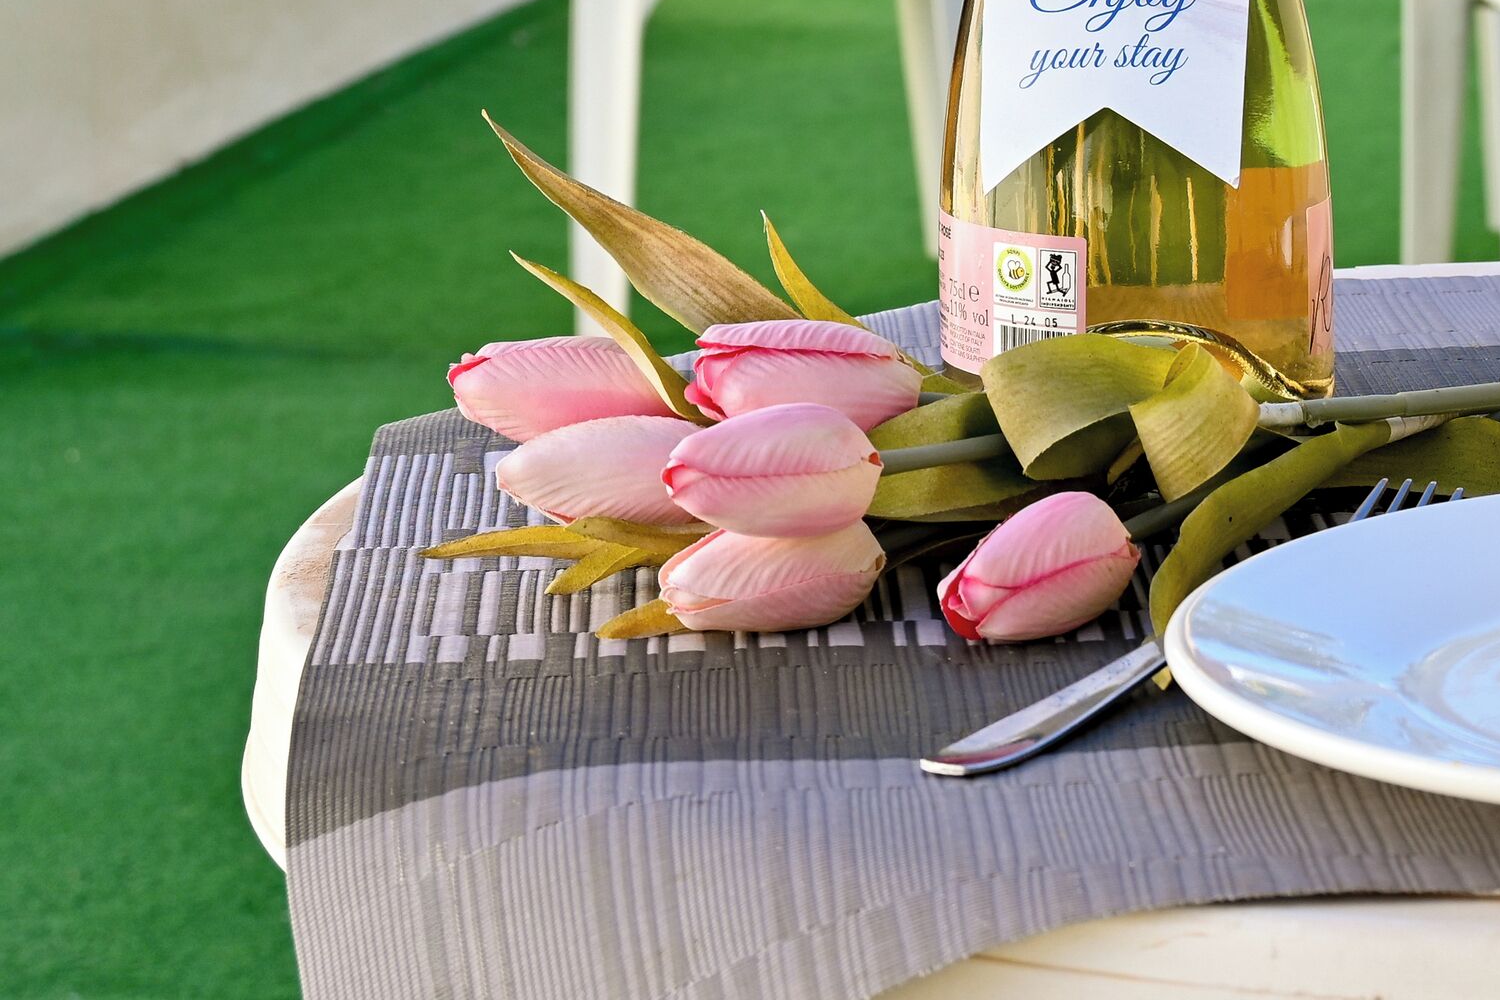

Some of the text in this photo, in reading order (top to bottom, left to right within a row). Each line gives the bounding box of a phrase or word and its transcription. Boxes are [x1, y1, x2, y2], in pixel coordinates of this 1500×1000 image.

[1018, 33, 1189, 90] your stay
[972, 309, 989, 327] vol
[1024, 315, 1036, 326] 24
